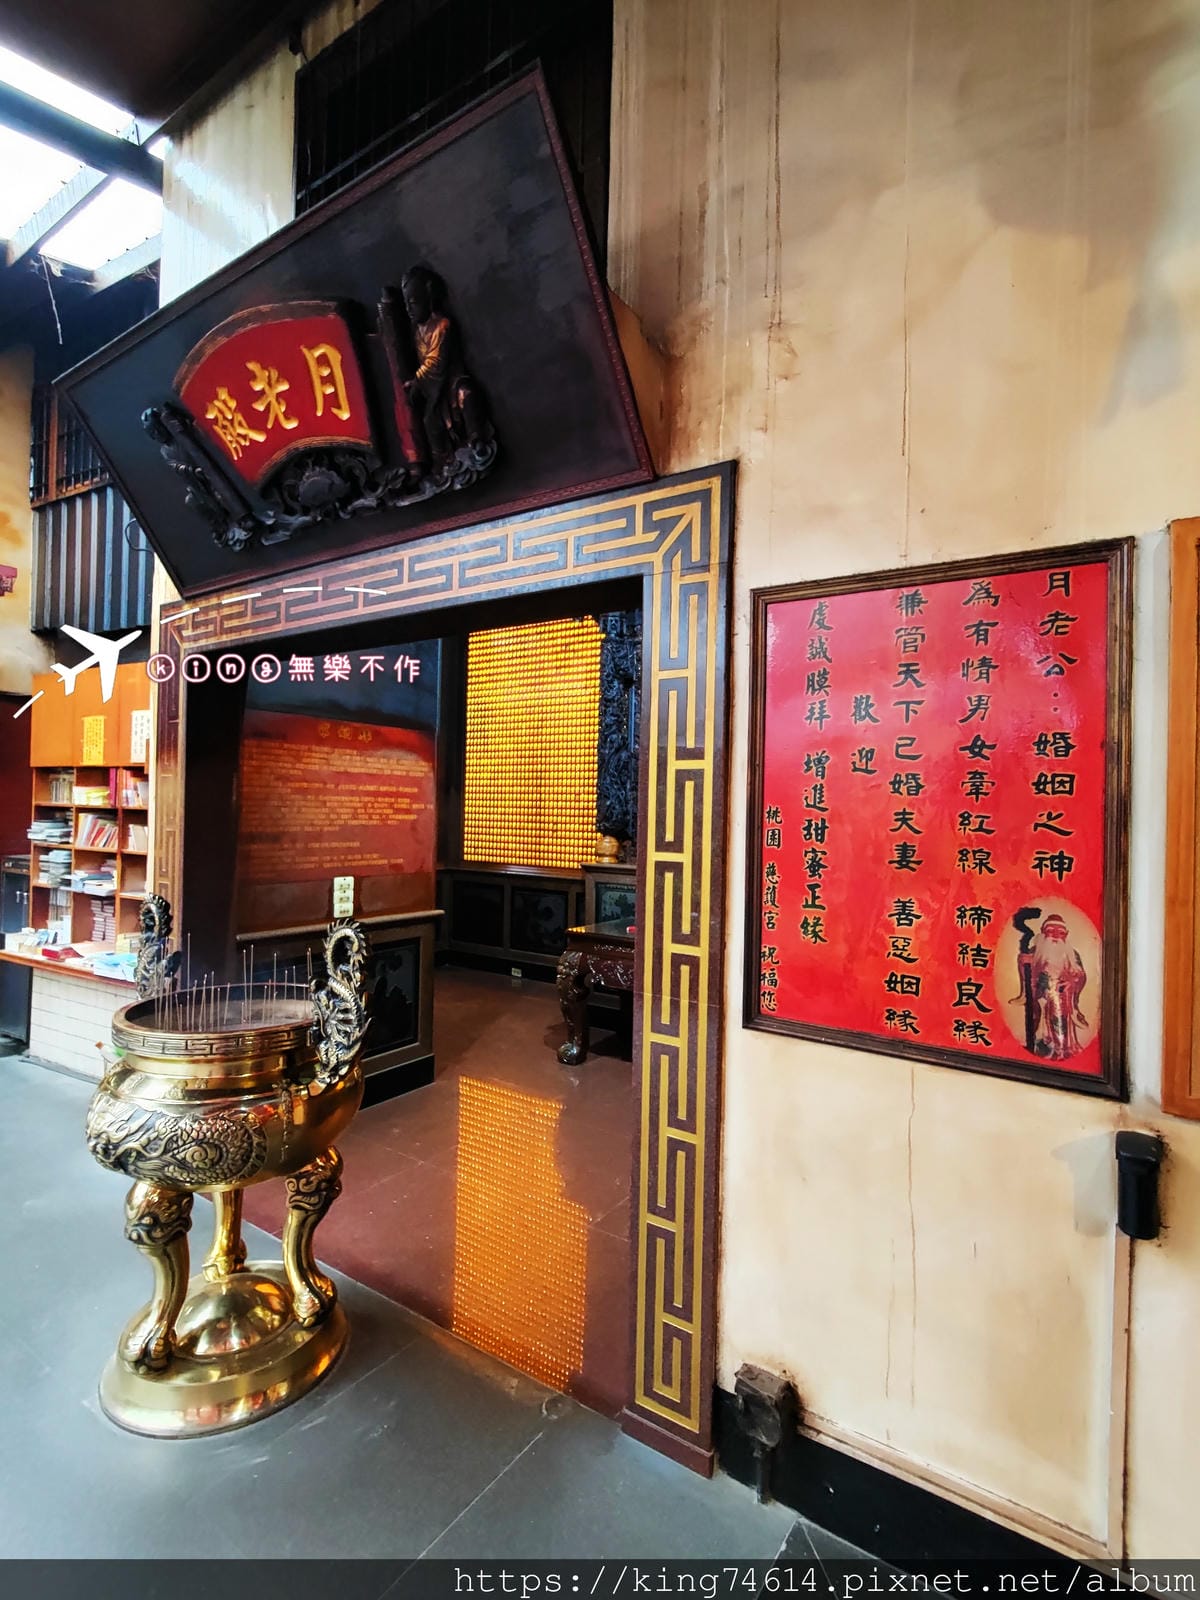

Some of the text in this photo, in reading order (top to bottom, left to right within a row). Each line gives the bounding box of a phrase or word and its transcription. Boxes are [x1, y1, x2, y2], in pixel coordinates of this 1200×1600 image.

[850, 694, 880, 776] 歡迎
[759, 805, 783, 1013] 桃園 慈護宮 祝福您
